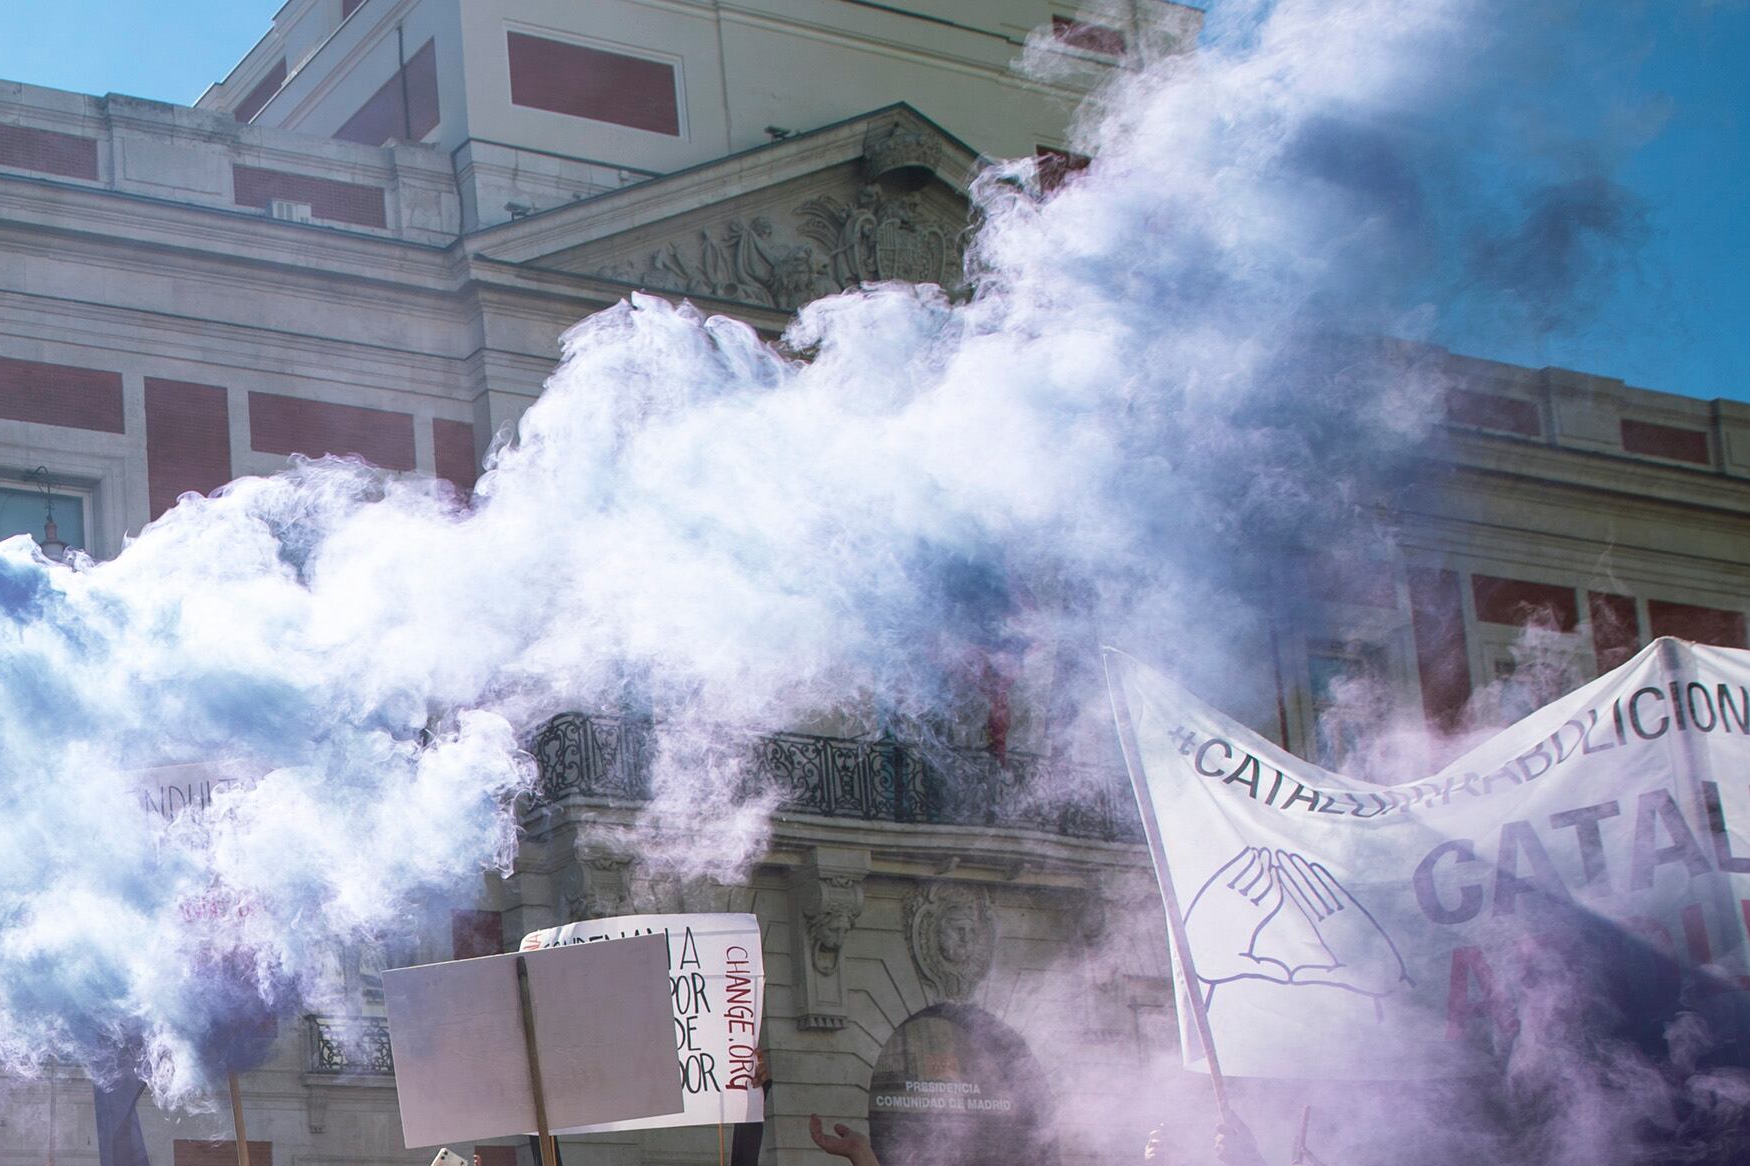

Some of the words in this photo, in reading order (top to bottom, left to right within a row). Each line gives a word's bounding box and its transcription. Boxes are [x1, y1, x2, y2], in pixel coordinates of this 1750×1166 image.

[723, 946, 756, 1090] CHANGE.ORG
[679, 1053, 721, 1093] OR
[905, 1081, 981, 1094] PRESIDENCIA
[876, 1096, 946, 1109] COMUNIDAD
[948, 1098, 964, 1109] DE
[967, 1099, 1011, 1111] MADRID
